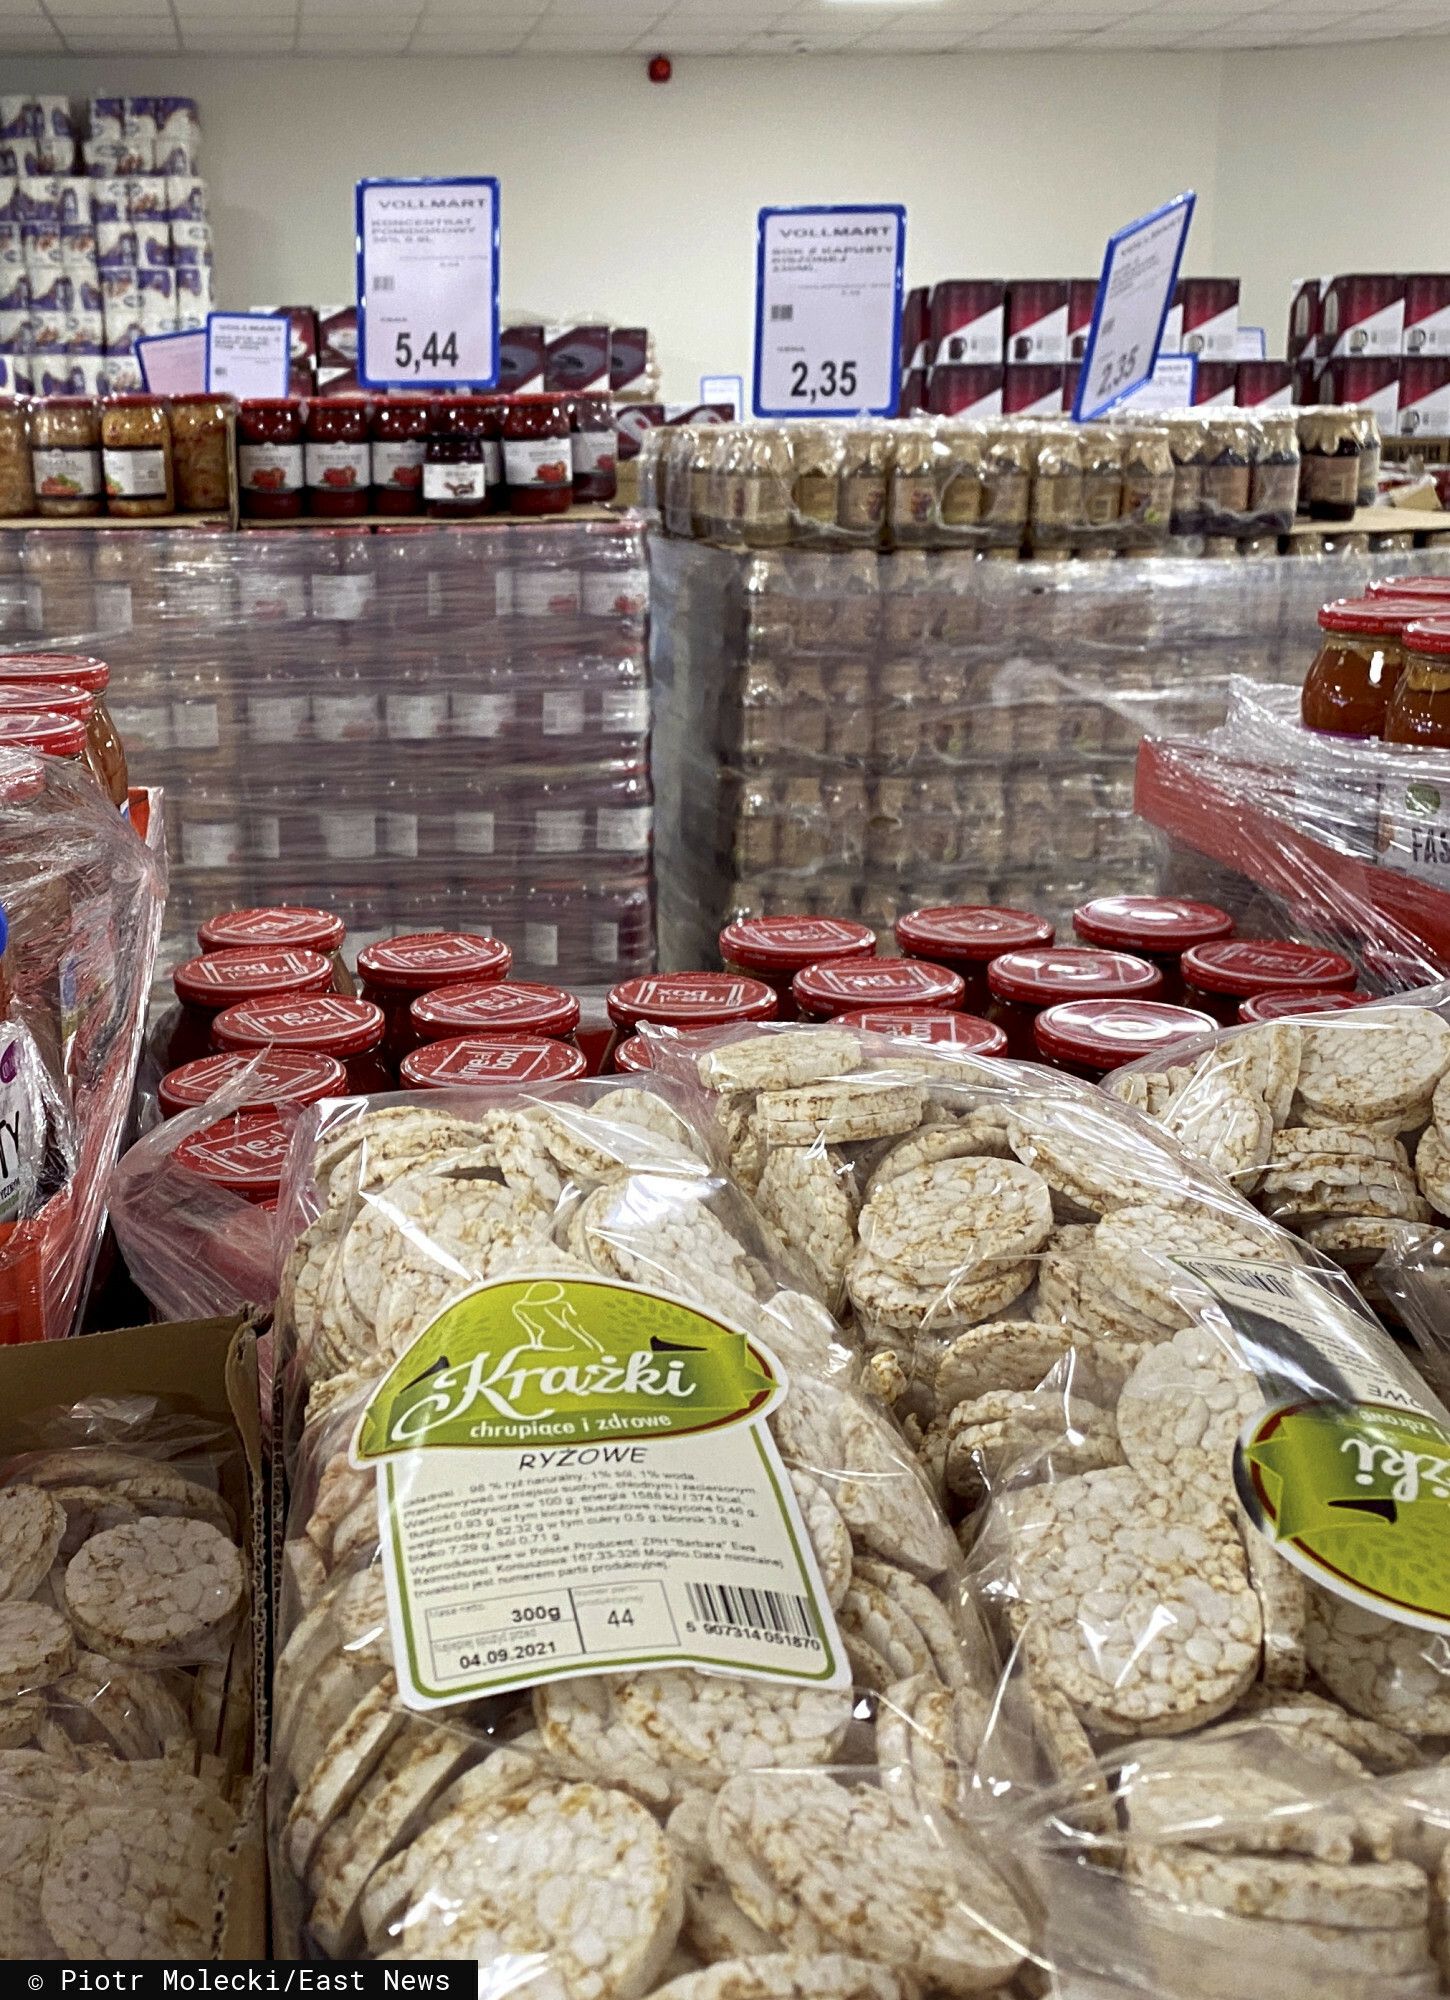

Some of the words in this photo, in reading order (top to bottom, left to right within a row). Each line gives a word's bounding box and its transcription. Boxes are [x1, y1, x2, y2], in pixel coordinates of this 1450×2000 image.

[379, 198, 486, 210] VOLLMART
[779, 225, 891, 239] VOLLMART
[395, 331, 460, 374] 5,44
[790, 360, 858, 404] 2,35
[391, 1345, 697, 1441] Krążki
[470, 1420, 575, 1440] chrupiące
[582, 1419, 590, 1432] i
[597, 1408, 672, 1431] zdrowe
[518, 1447, 648, 1471] RYŻOWE
[511, 1605, 561, 1623] 300g
[607, 1608, 635, 1628] 44
[459, 1641, 557, 1669] 04.09.2021
